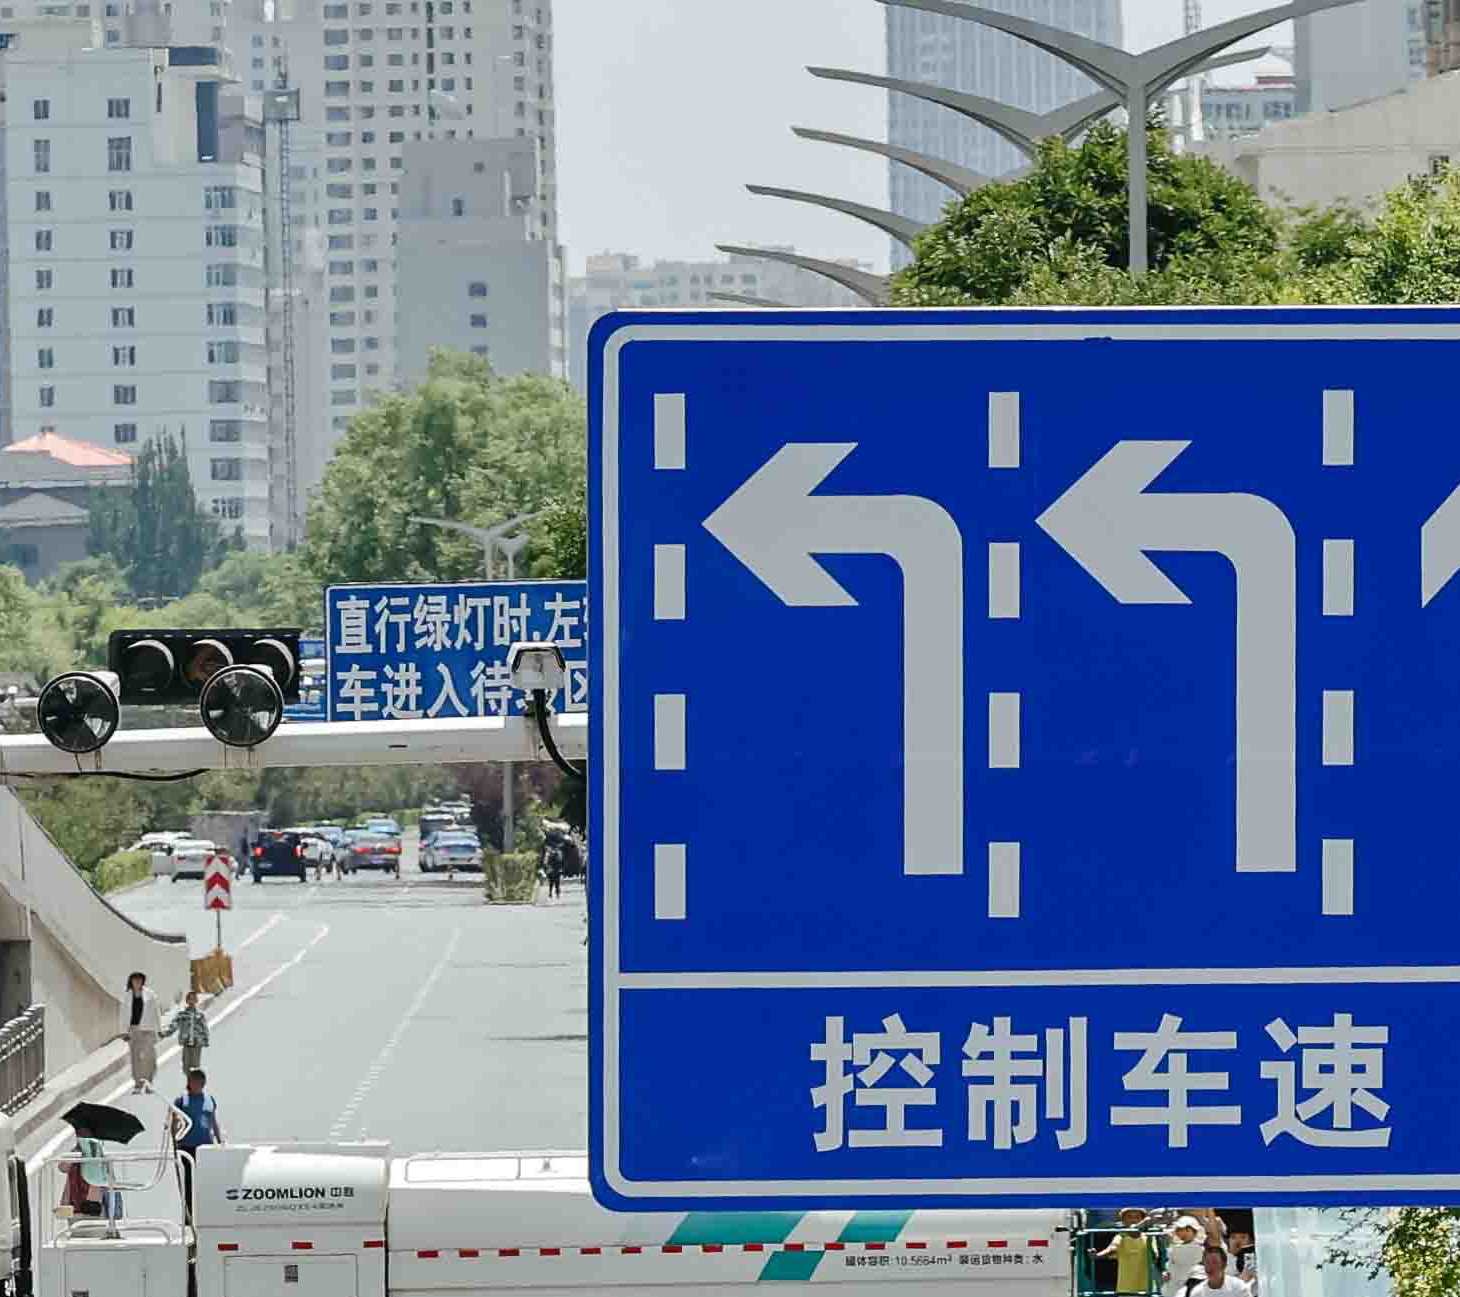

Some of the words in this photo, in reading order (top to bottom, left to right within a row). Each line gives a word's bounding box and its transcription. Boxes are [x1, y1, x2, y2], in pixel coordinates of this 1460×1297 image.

[335, 593, 587, 654] 直行绿灯时,左
[336, 661, 587, 720] 车进入待区
[807, 1014, 1395, 1152] 控制车速
[242, 1188, 325, 1200] ZOOMLION
